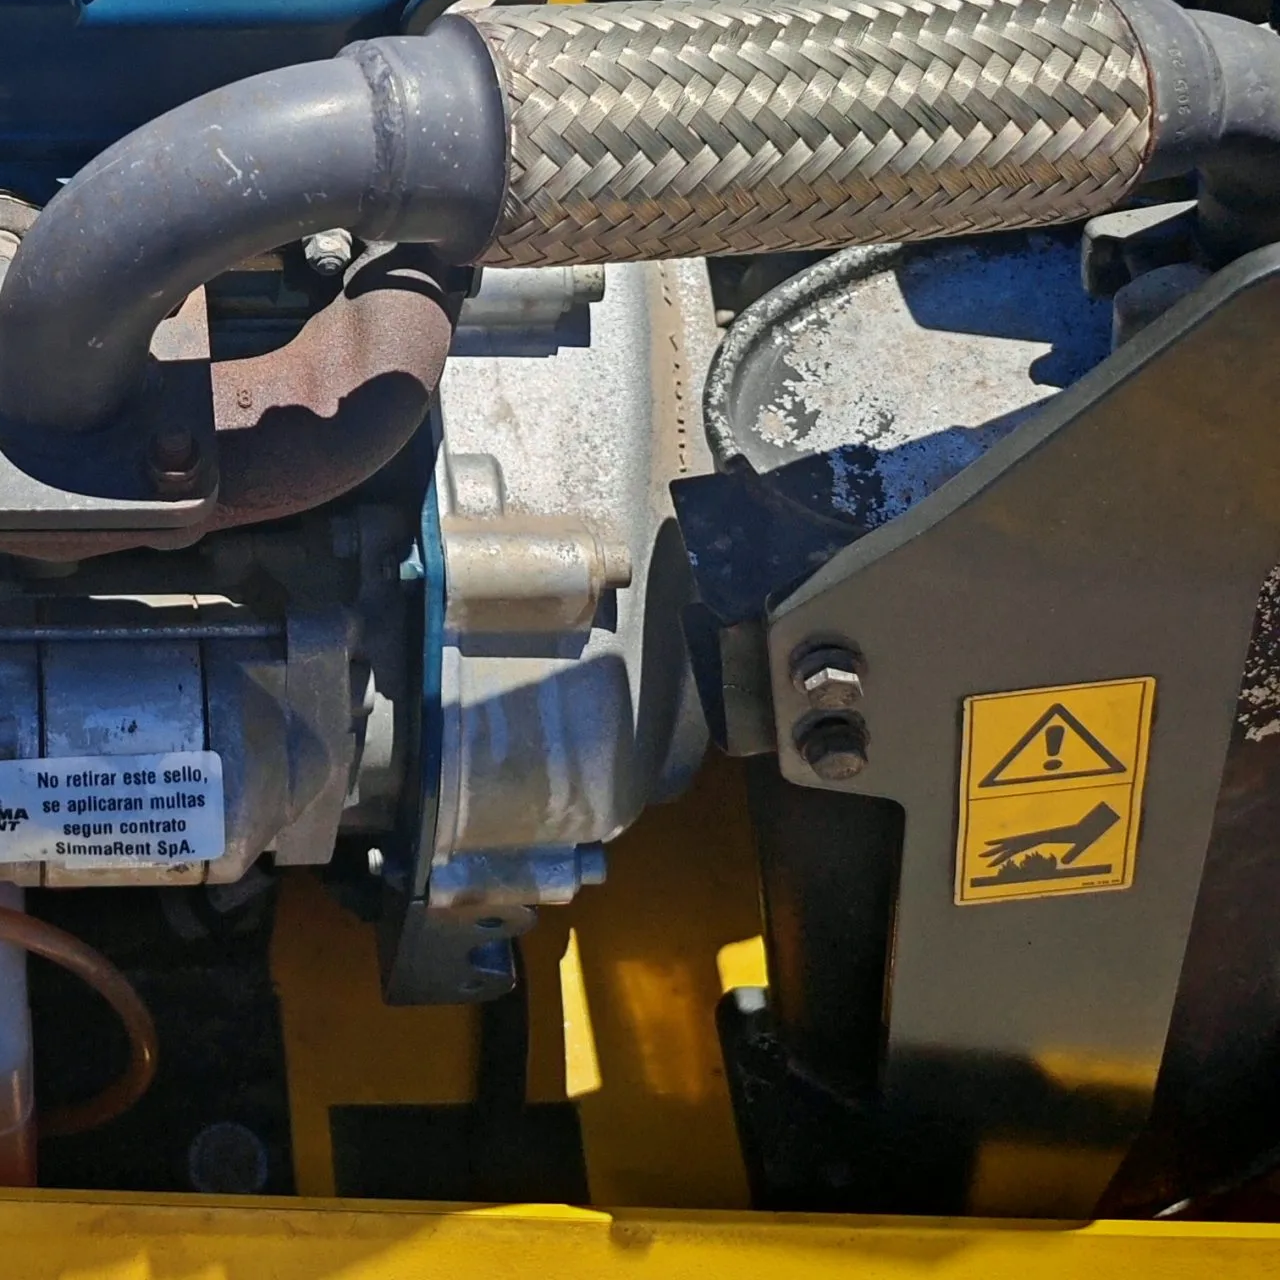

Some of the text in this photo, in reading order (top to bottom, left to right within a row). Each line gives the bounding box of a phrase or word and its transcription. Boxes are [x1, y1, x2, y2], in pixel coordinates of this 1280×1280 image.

[37, 766, 208, 788] No retirar este sello,
[42, 792, 206, 818] se aplicaran multas
[63, 818, 187, 838] segun contrato
[55, 839, 196, 858] SimmaRent SpA.
